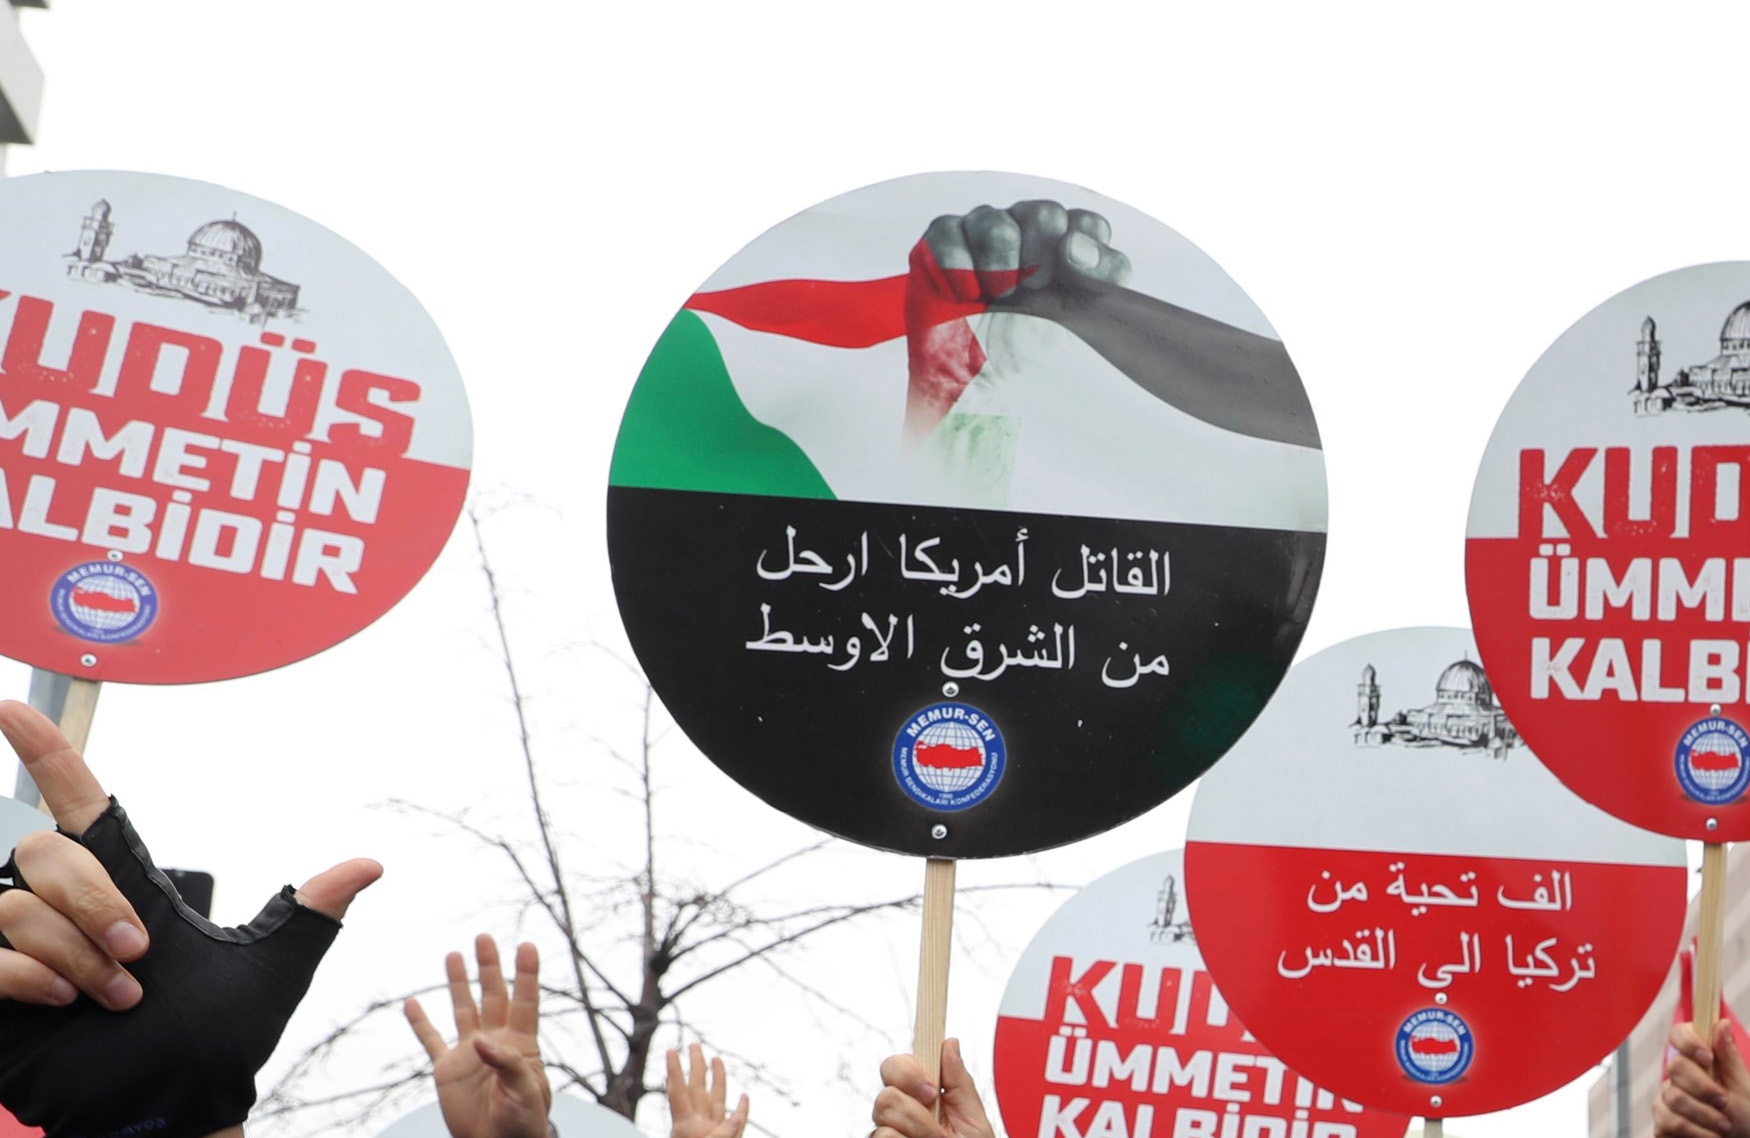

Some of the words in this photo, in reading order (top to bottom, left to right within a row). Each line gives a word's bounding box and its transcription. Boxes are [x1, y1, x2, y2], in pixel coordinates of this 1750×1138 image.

[0, 290, 421, 458] UDÜS
[0, 468, 365, 595] LBİDİR
[755, 526, 868, 589] ارحل
[66, 564, 152, 596] MEMUR-SEN
[900, 528, 1028, 601] أمريكا
[1051, 544, 1171, 598] القاتل
[745, 604, 915, 670] الاوسط
[941, 622, 1076, 680] الشرق
[1101, 643, 1169, 687] من
[906, 707, 995, 741] MEMUR-SEN
[1683, 720, 1749, 748] MEMUR-SEN
[1306, 872, 1368, 911] من
[1385, 862, 1479, 918] تحية
[1496, 869, 1572, 911] الف
[1276, 927, 1397, 977] القدس
[1503, 934, 1596, 992] تركيا
